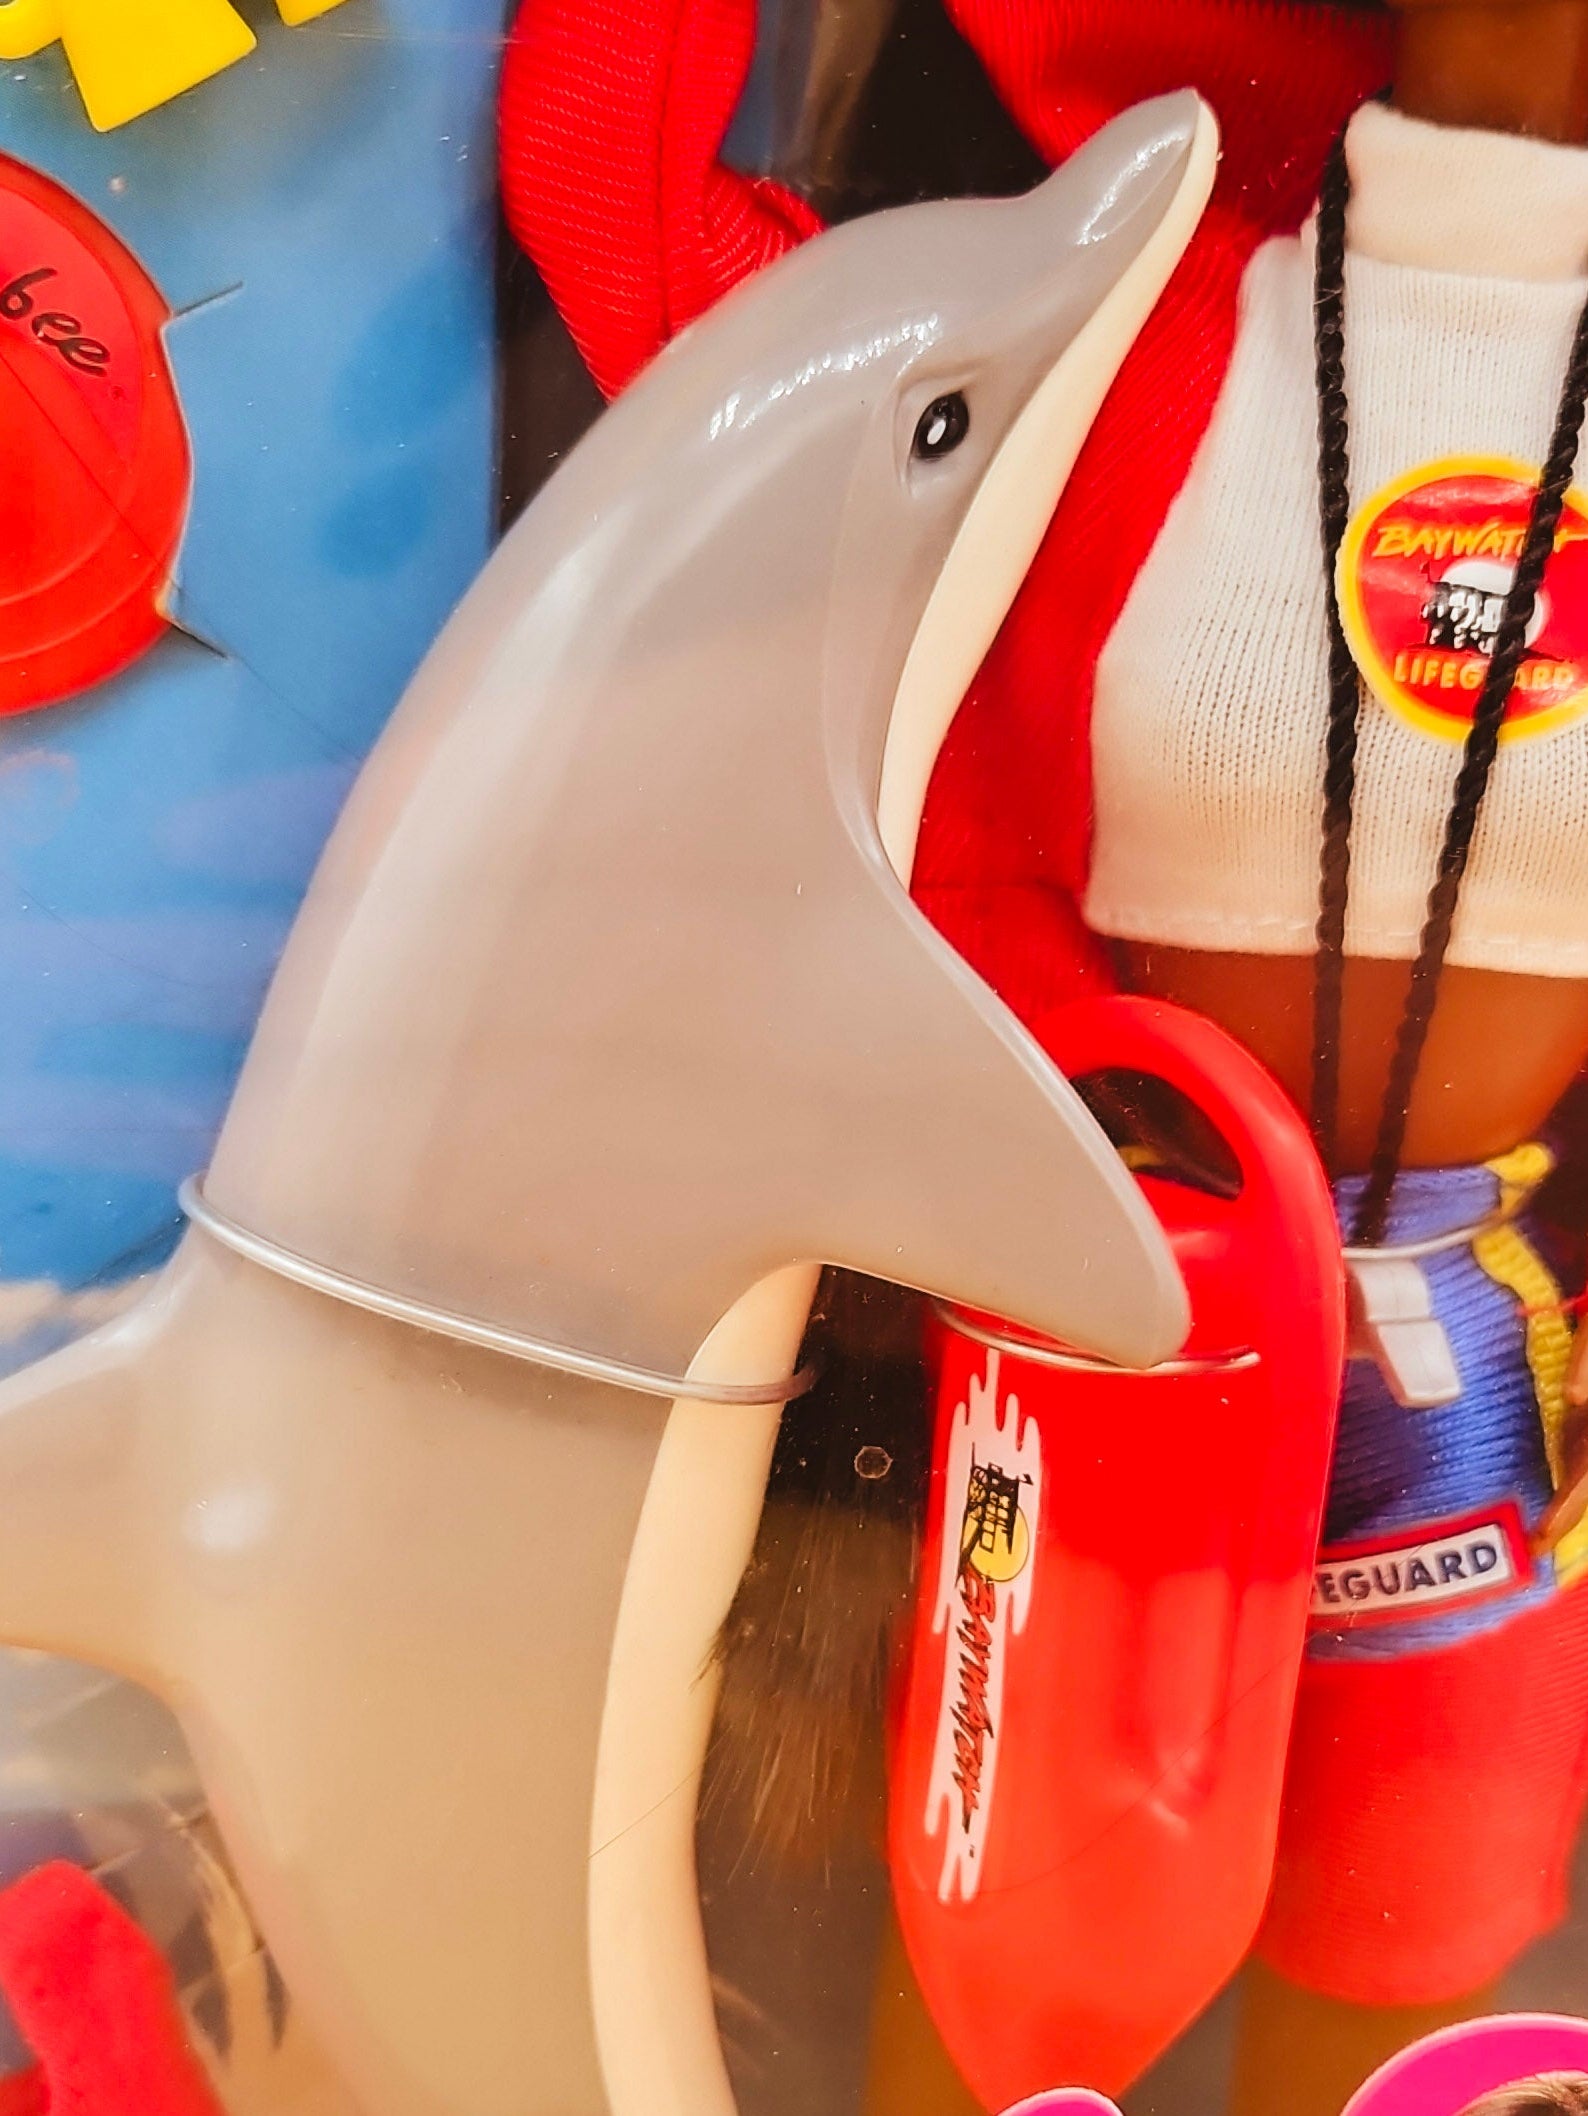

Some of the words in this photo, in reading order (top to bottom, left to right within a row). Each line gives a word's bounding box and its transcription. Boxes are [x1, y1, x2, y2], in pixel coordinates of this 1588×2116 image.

[0, 267, 109, 377] bee
[1394, 653, 1575, 690] LIFEGARD
[1312, 1540, 1498, 1604] EGUARD
